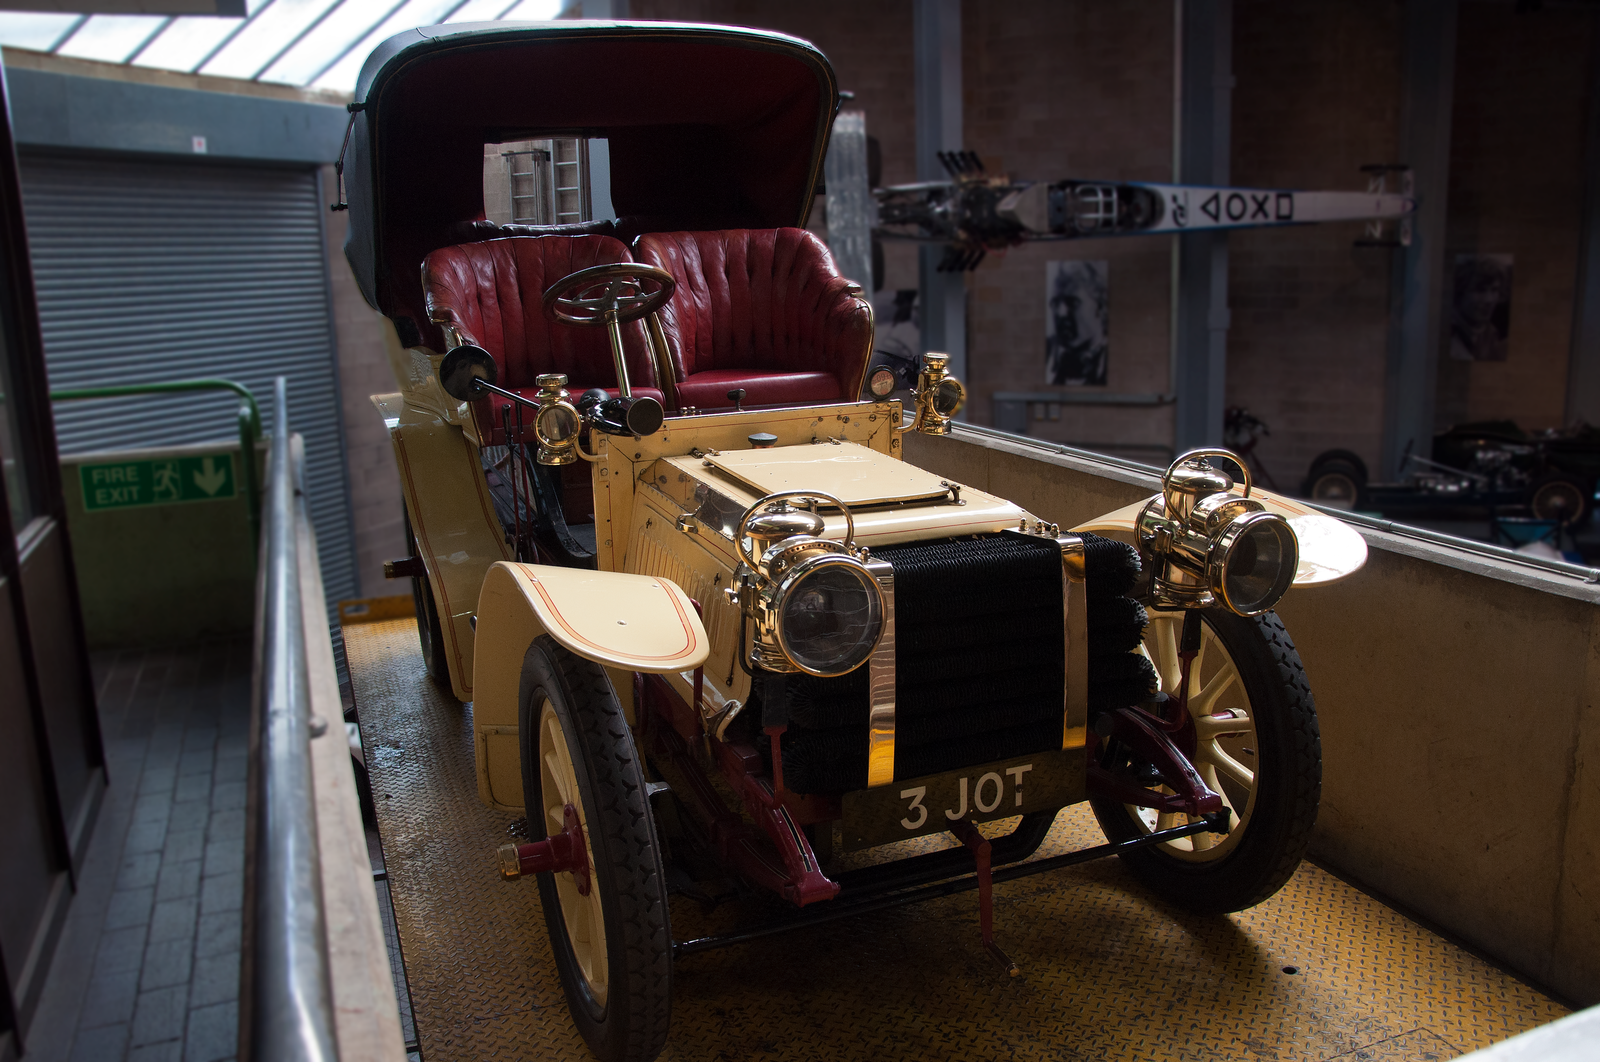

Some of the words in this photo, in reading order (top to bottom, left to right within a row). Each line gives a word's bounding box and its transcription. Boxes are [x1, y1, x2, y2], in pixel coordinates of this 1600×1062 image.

[91, 465, 140, 485] FIRE
[94, 485, 140, 505] EXIT
[900, 785, 928, 830] 3
[944, 763, 1033, 821] JOT
